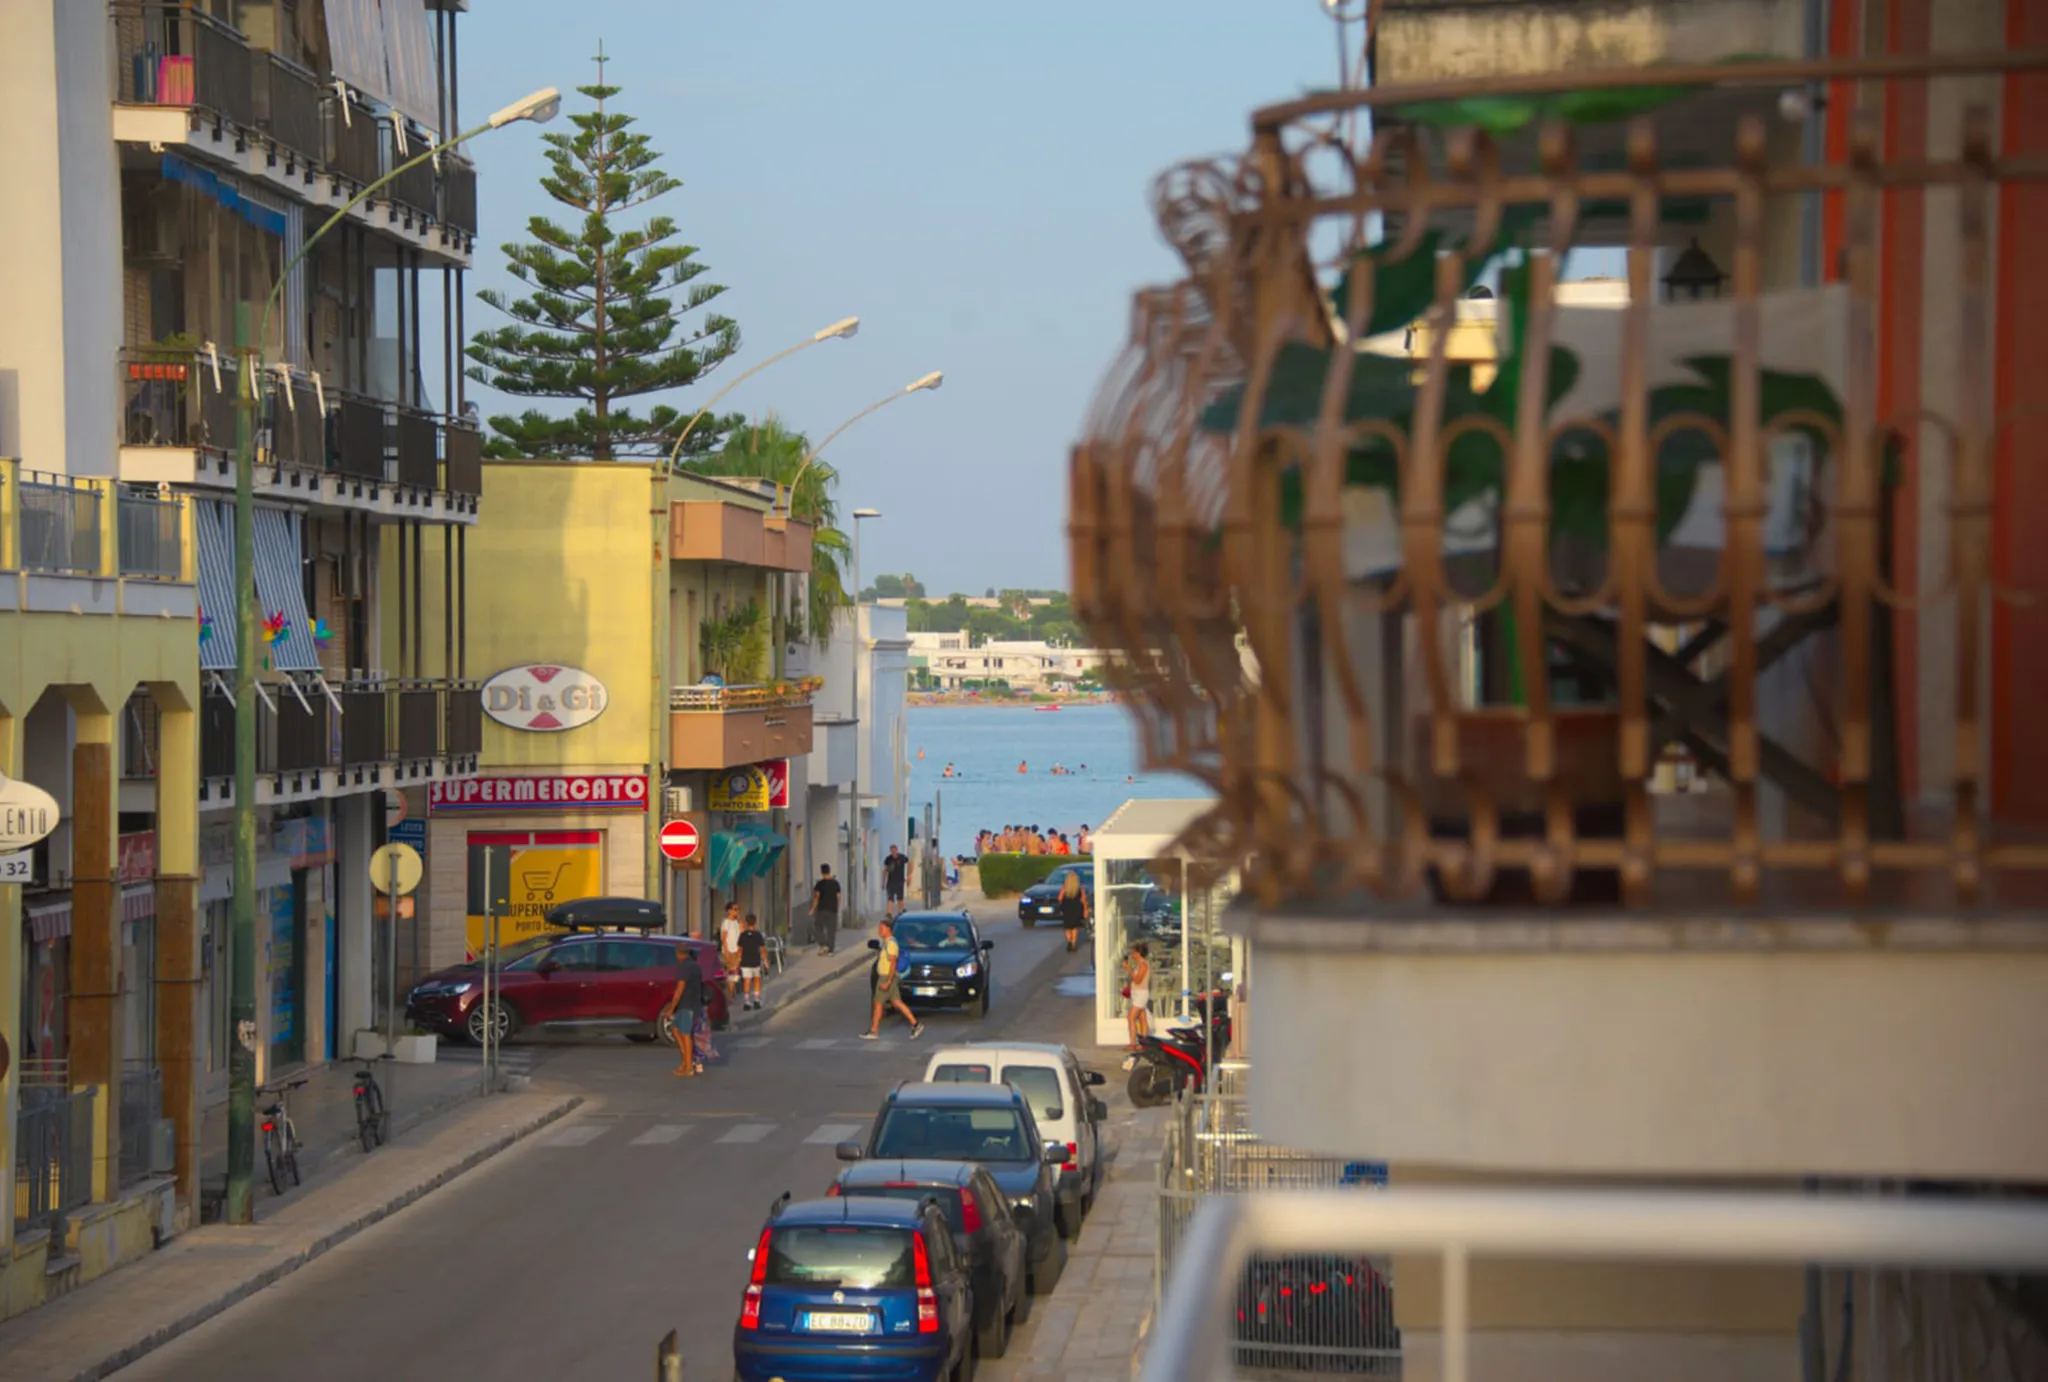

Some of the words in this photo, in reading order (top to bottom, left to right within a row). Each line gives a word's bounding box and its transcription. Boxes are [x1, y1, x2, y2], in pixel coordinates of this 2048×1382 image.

[488, 685, 531, 711] Di
[562, 685, 601, 711] Gi
[432, 778, 645, 801] SUPERMERCATO
